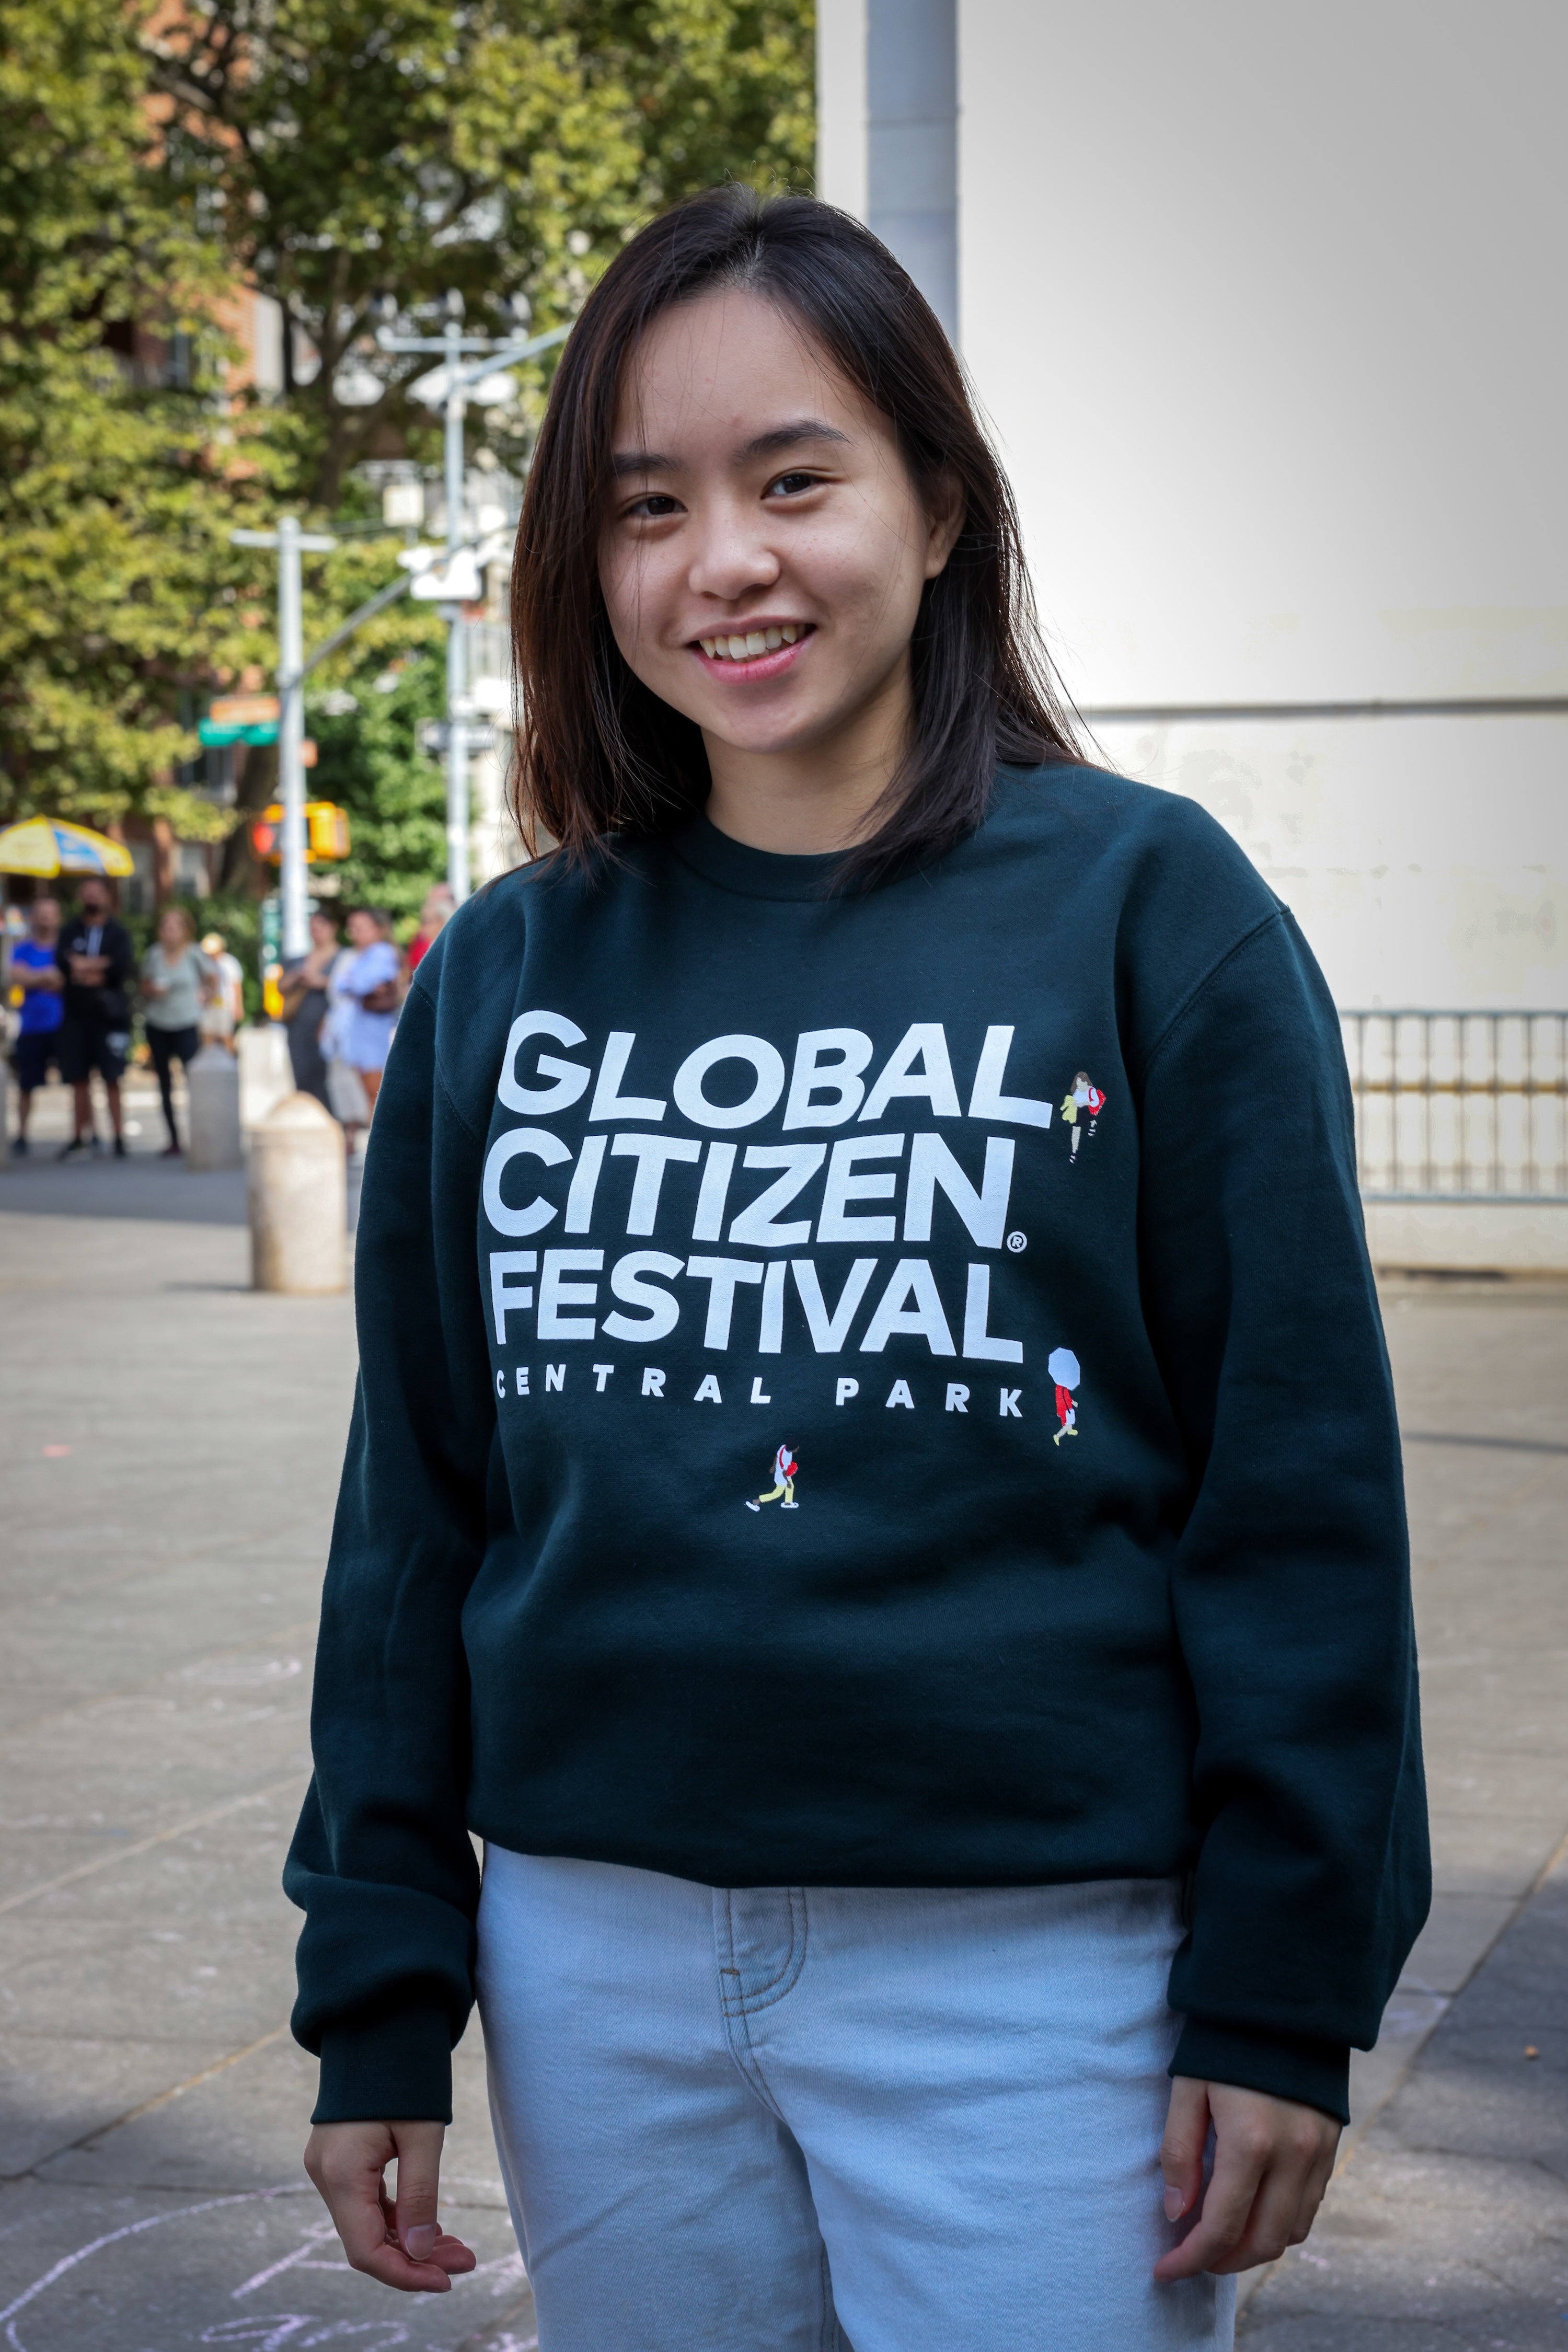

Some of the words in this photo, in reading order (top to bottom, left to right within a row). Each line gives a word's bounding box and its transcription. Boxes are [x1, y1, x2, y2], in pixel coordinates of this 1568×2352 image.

[497, 1010, 1053, 1131] GLOBAL
[489, 1248, 1023, 1364] FESTIVAL
[496, 1363, 772, 1405] CENTRAL
[835, 1377, 1023, 1418] PARK
